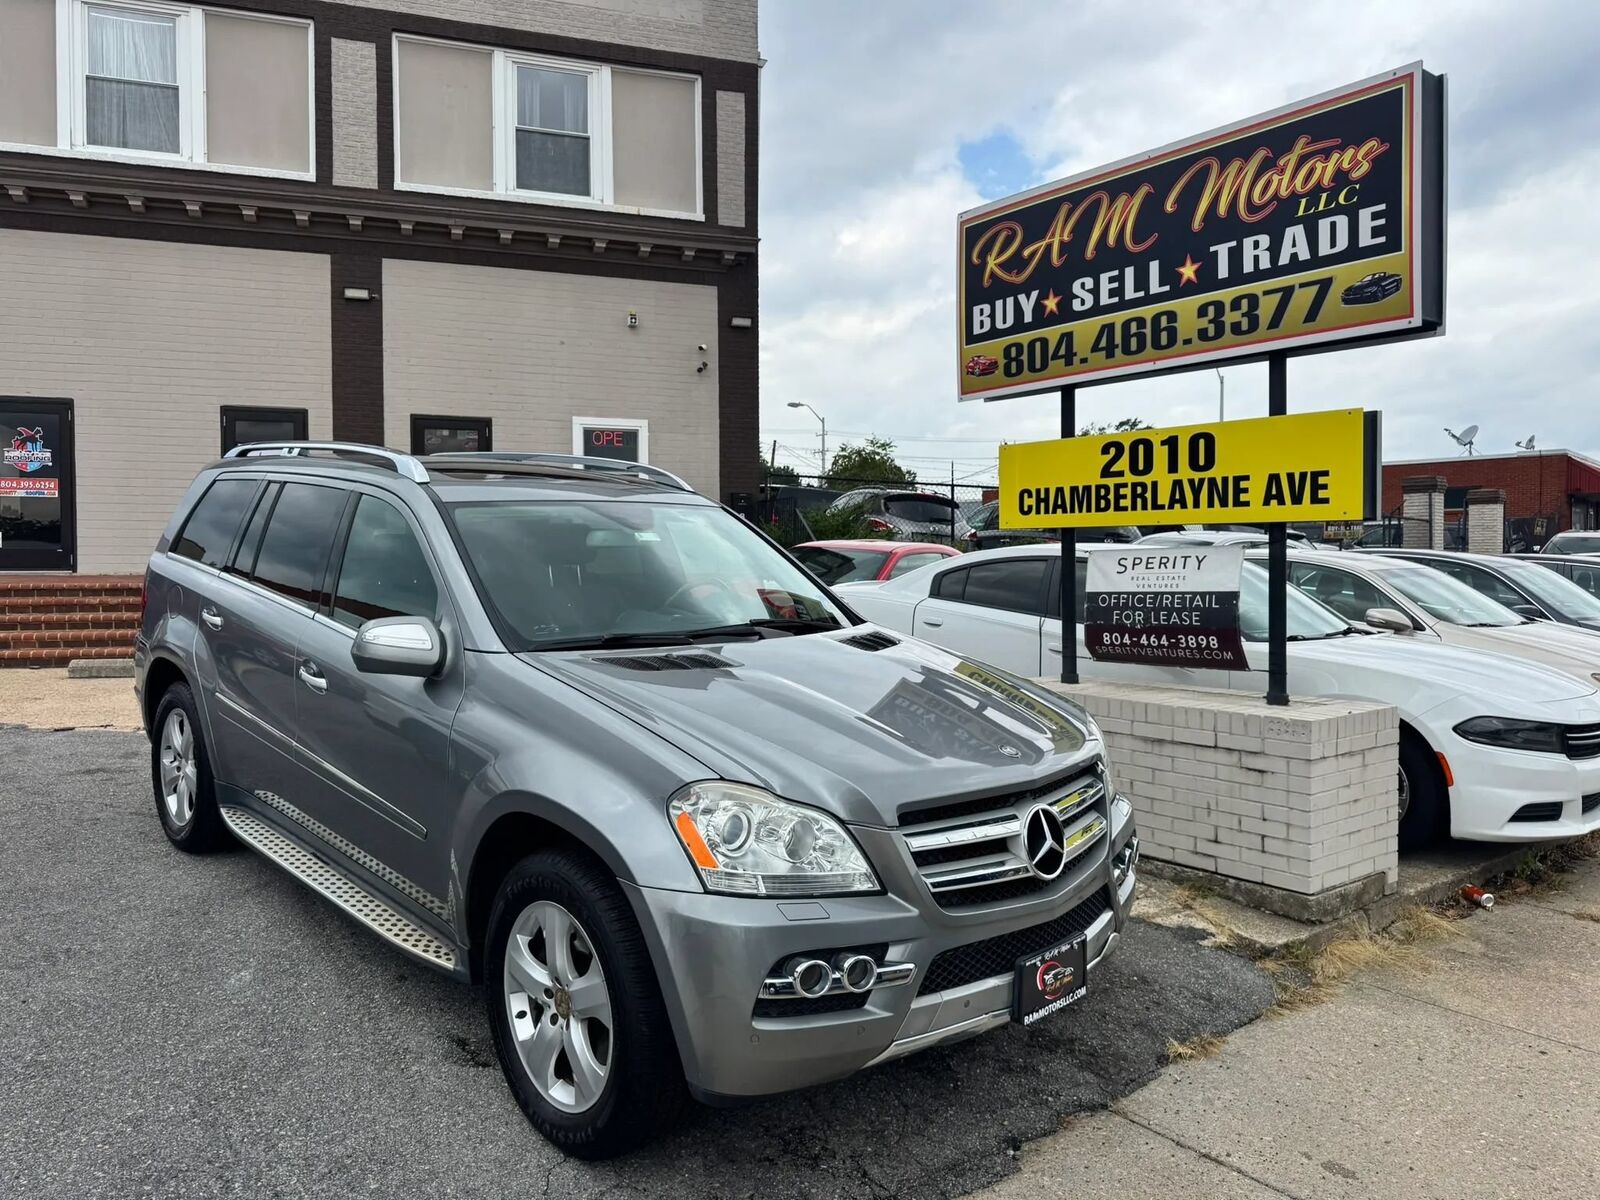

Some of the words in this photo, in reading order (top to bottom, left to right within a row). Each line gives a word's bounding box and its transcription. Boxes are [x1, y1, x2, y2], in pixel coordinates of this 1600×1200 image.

[1164, 135, 1390, 232] Motors
[1295, 184, 1360, 217] LLC
[972, 289, 1040, 336] BUY
[1071, 259, 1170, 312] SELL
[1209, 203, 1387, 280] TRADE
[1003, 277, 1336, 379] 804.466.3377
[1100, 432, 1216, 479] 2010
[0, 481, 55, 489] 804.395.6254
[1018, 475, 1251, 516] CHAMBERLAYNE
[1262, 470, 1331, 507] AVE
[1116, 555, 1207, 574] SPERITY
[1098, 594, 1220, 608] OFFICE/RETAIL
[1113, 610, 1144, 624] FOR
[1151, 611, 1201, 626] LEASE
[1095, 645, 1234, 660] SPERITYVENTURES.COM
[1102, 632, 1219, 649] 804-464-3898
[1024, 986, 1087, 1025] RAMMOTORSLLC.COM
